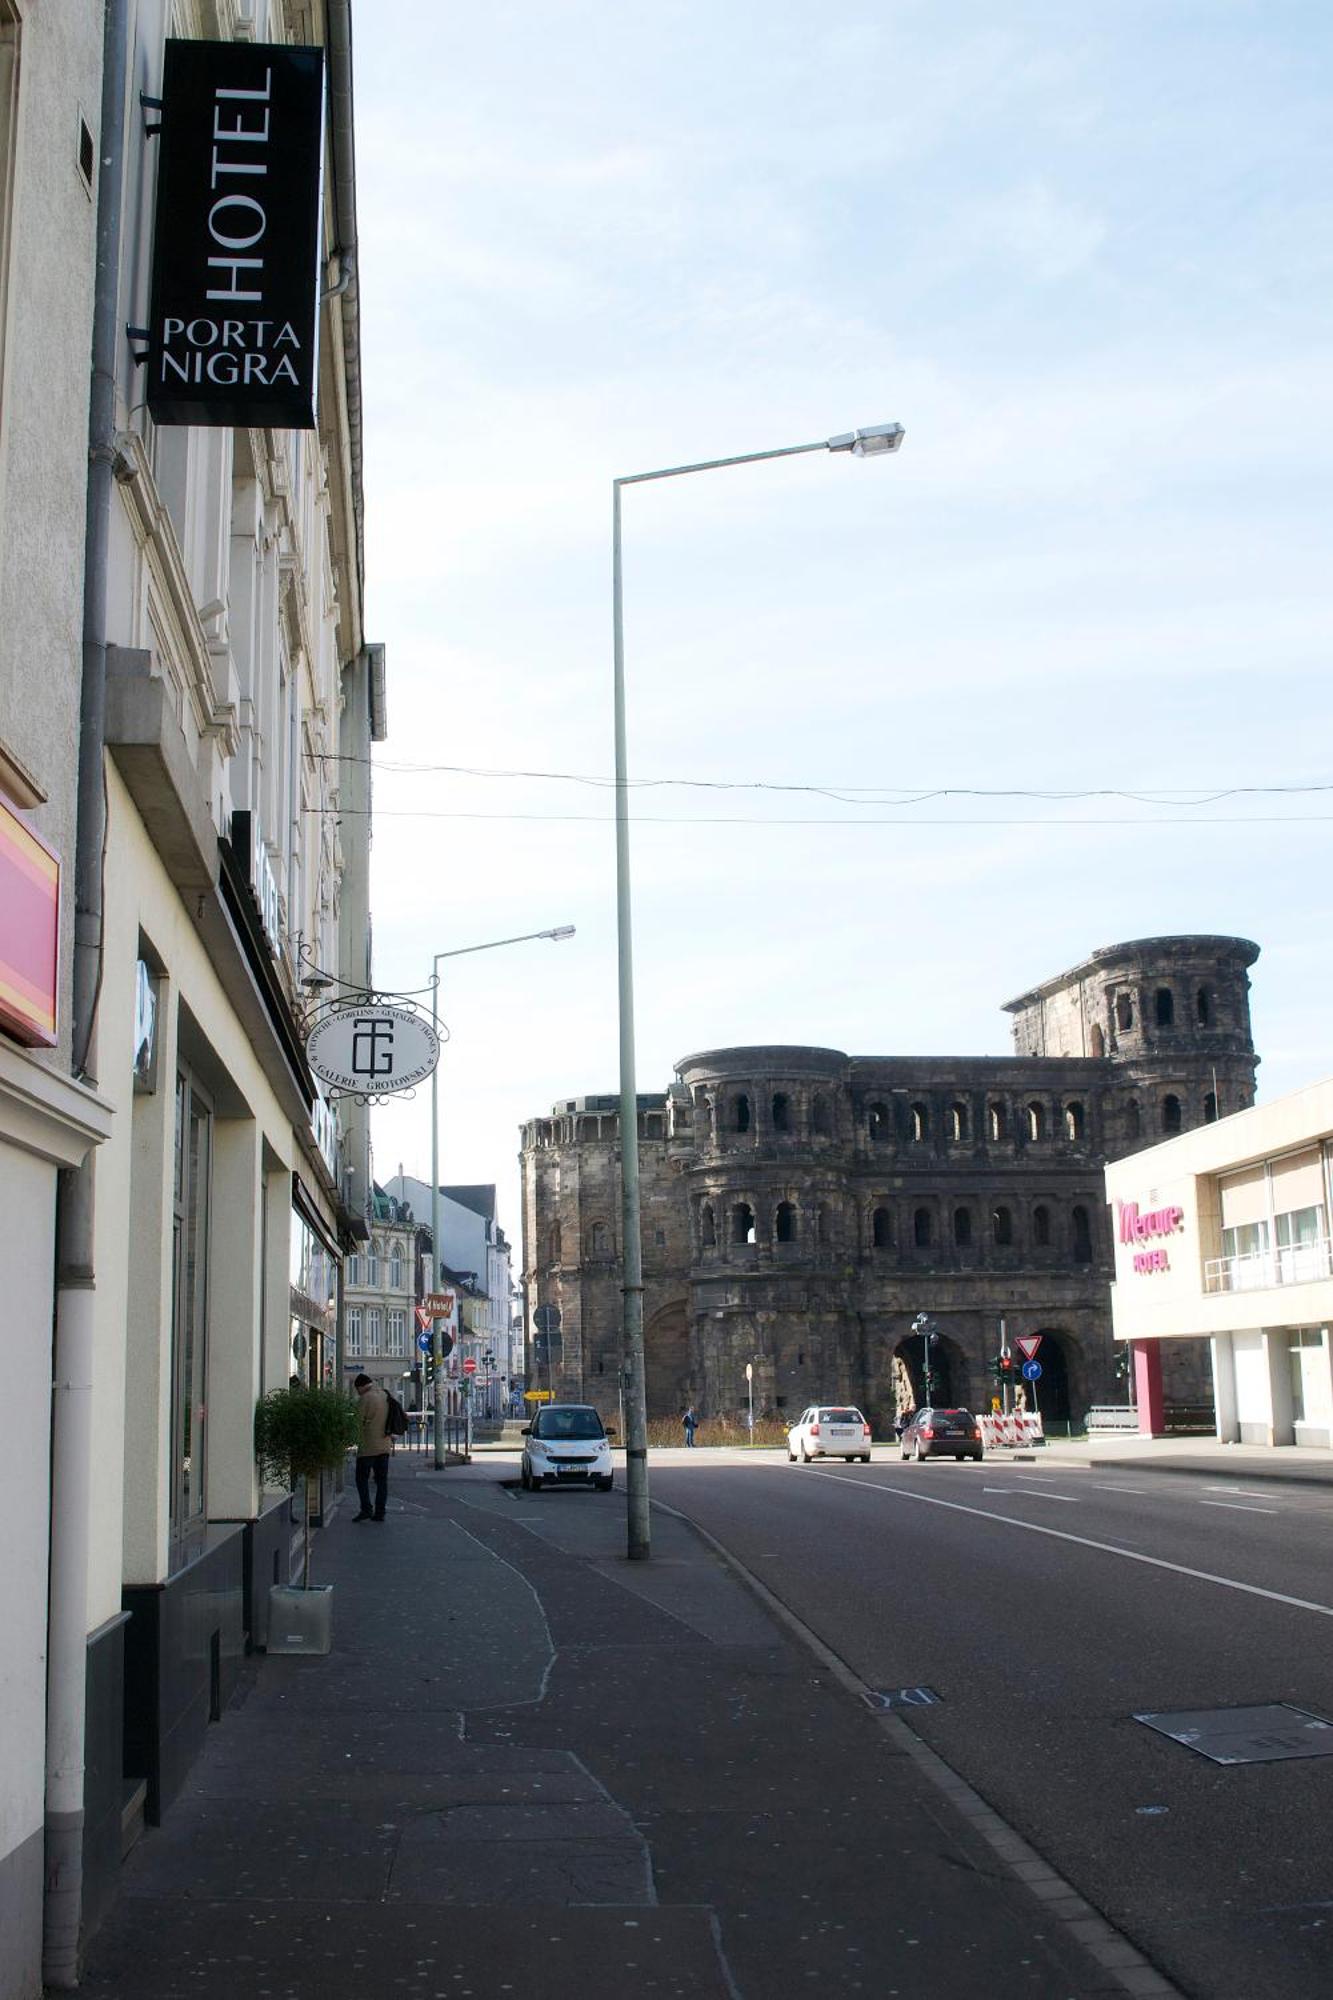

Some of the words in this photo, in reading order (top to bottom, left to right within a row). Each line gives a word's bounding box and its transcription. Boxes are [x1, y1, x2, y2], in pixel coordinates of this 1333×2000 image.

[206, 67, 271, 301] HOTEL
[163, 318, 301, 349] PORTA
[161, 350, 300, 386] NIGRA
[317, 1064, 358, 1089] GALERIE
[367, 1066, 427, 1090] GROTOWSKI
[1118, 1200, 1184, 1244] Mercure
